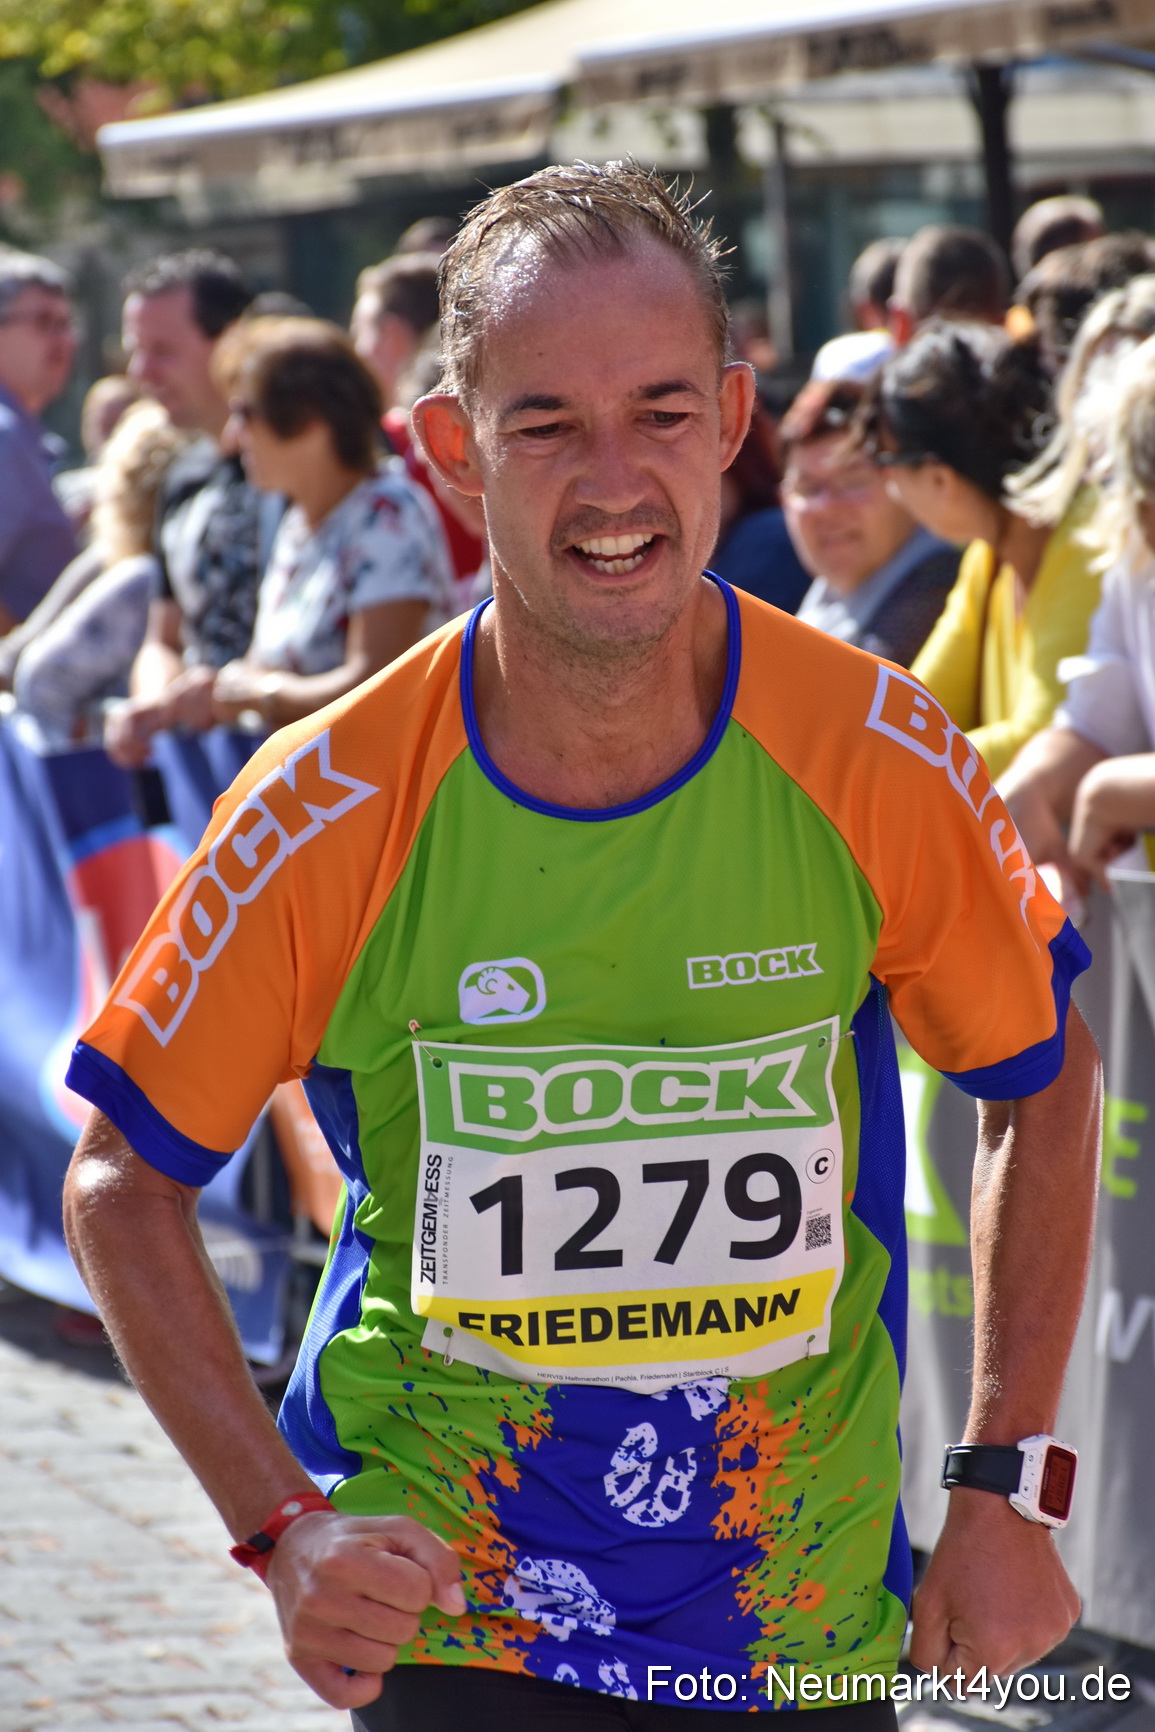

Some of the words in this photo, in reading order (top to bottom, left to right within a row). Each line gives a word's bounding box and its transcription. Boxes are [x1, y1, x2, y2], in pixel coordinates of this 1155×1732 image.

[113, 728, 380, 1048] BOCK
[687, 942, 824, 989] BOCK
[448, 1044, 817, 1141] BOCK
[443, 1156, 454, 1218] ZEITMESSUNG
[469, 1152, 802, 1276] 1279
[457, 1287, 801, 1347] FRIEDEMANN
[537, 1371, 563, 1381] HERVIS
[564, 1375, 610, 1383] Halbmarathon
[640, 1372, 678, 1381] Friedemann
[682, 1368, 714, 1378] Startblock
